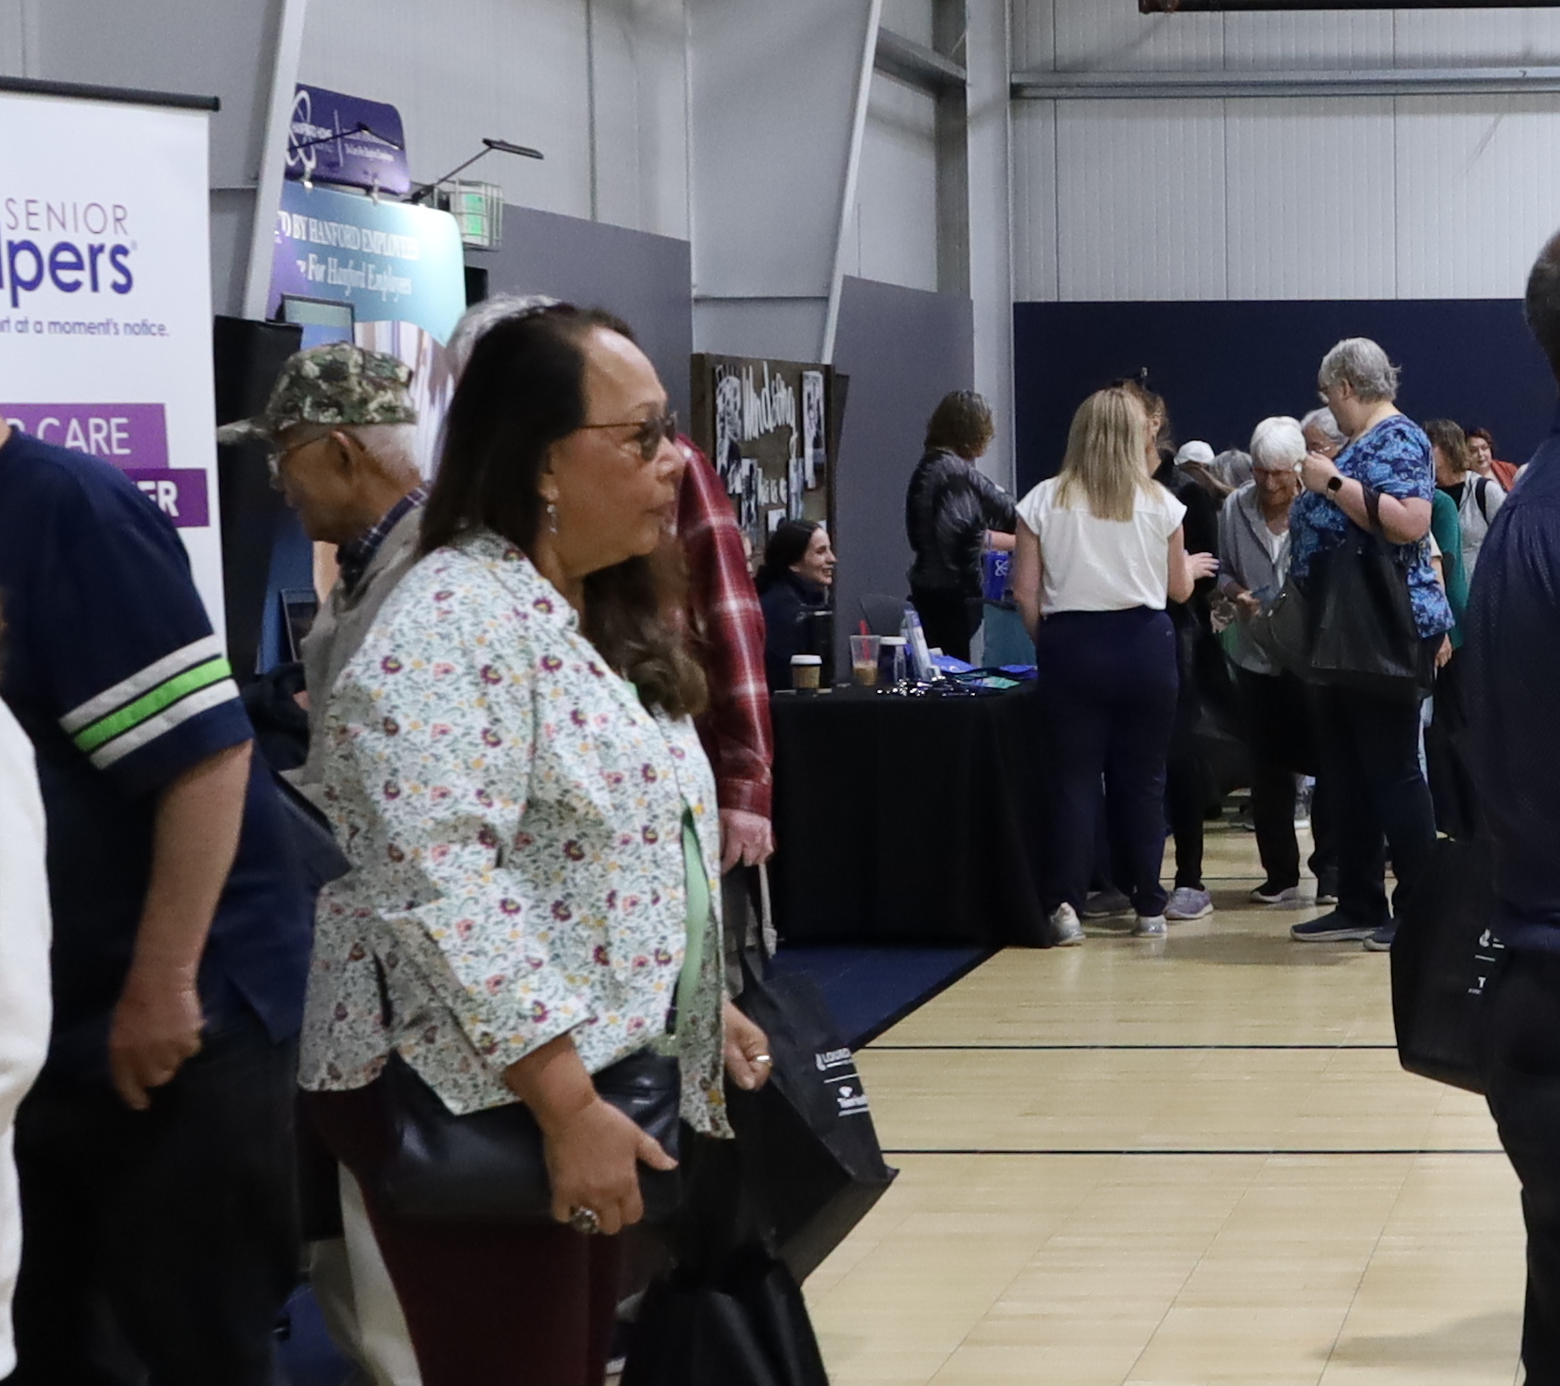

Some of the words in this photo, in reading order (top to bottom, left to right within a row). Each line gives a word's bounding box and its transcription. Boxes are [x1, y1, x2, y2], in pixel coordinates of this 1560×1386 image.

[5, 197, 129, 236] SENIOR
[292, 214, 308, 241] BY
[309, 217, 360, 251] HANFORD
[361, 225, 420, 261] EMPLOYEES
[308, 253, 326, 282] For
[15, 319, 29, 334] at
[33, 322, 43, 334] a
[48, 317, 120, 336] moment's
[123, 319, 170, 337] notice.
[37, 417, 132, 455] CARE
